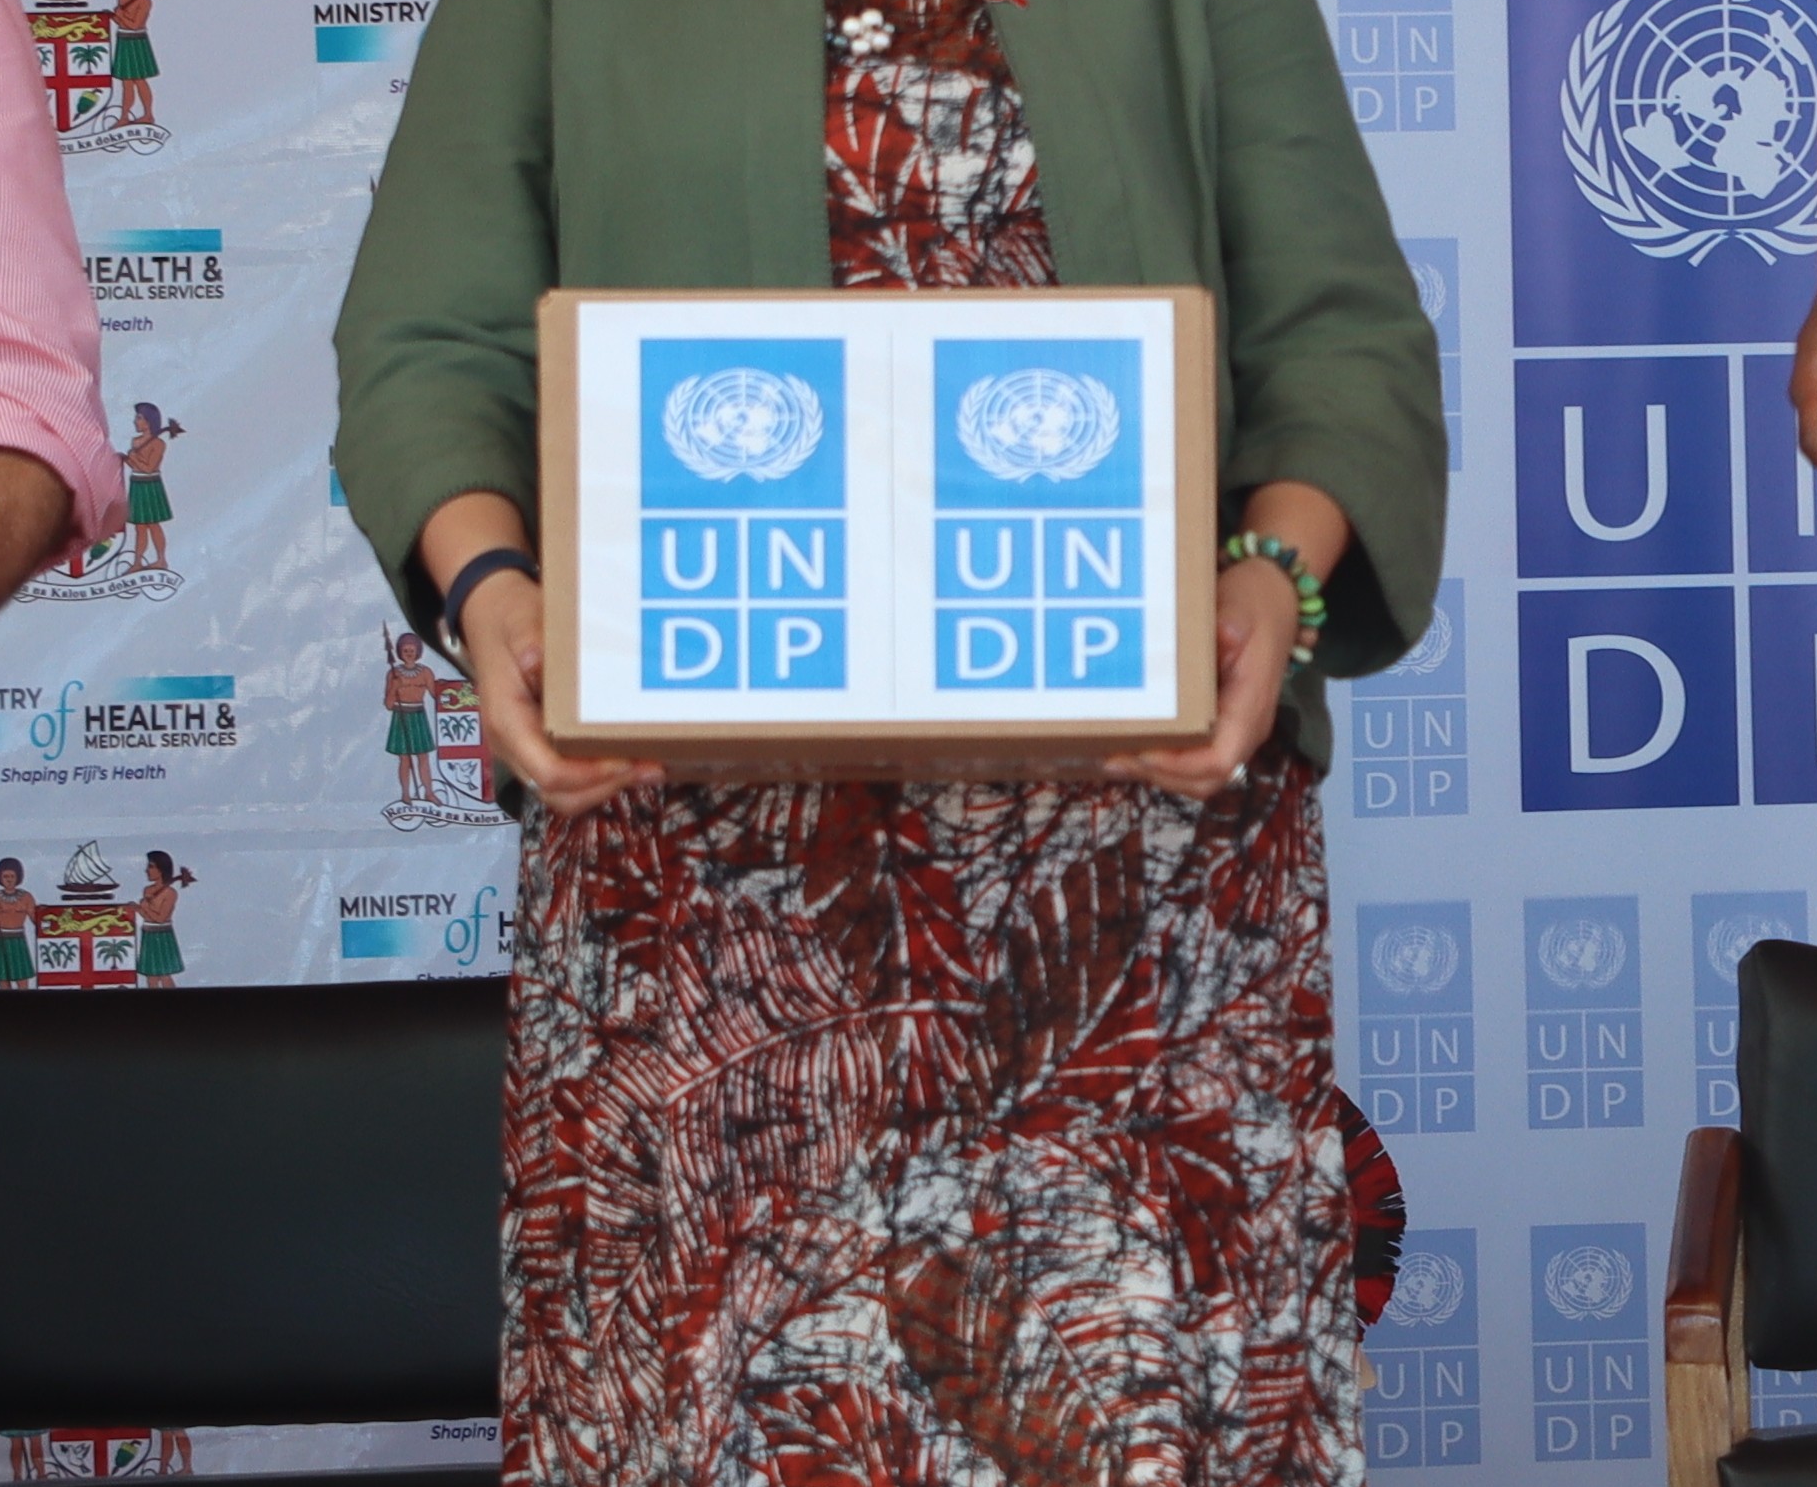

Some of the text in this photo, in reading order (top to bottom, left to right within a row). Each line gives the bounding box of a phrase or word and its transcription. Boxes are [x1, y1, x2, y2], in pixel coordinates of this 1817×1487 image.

[315, 1, 430, 25] MINISTRY
[202, 257, 222, 283] &
[148, 284, 224, 300] SERVICES
[100, 315, 153, 332] Health
[30, 681, 83, 761] of
[84, 704, 205, 732] HEALTH
[216, 703, 236, 729] &
[84, 731, 238, 749] MEDICAL SERVICES
[0, 764, 166, 785] Shaping Fiji's Health
[340, 888, 496, 969] MINISTRY of
[430, 1423, 497, 1442] Shaping
